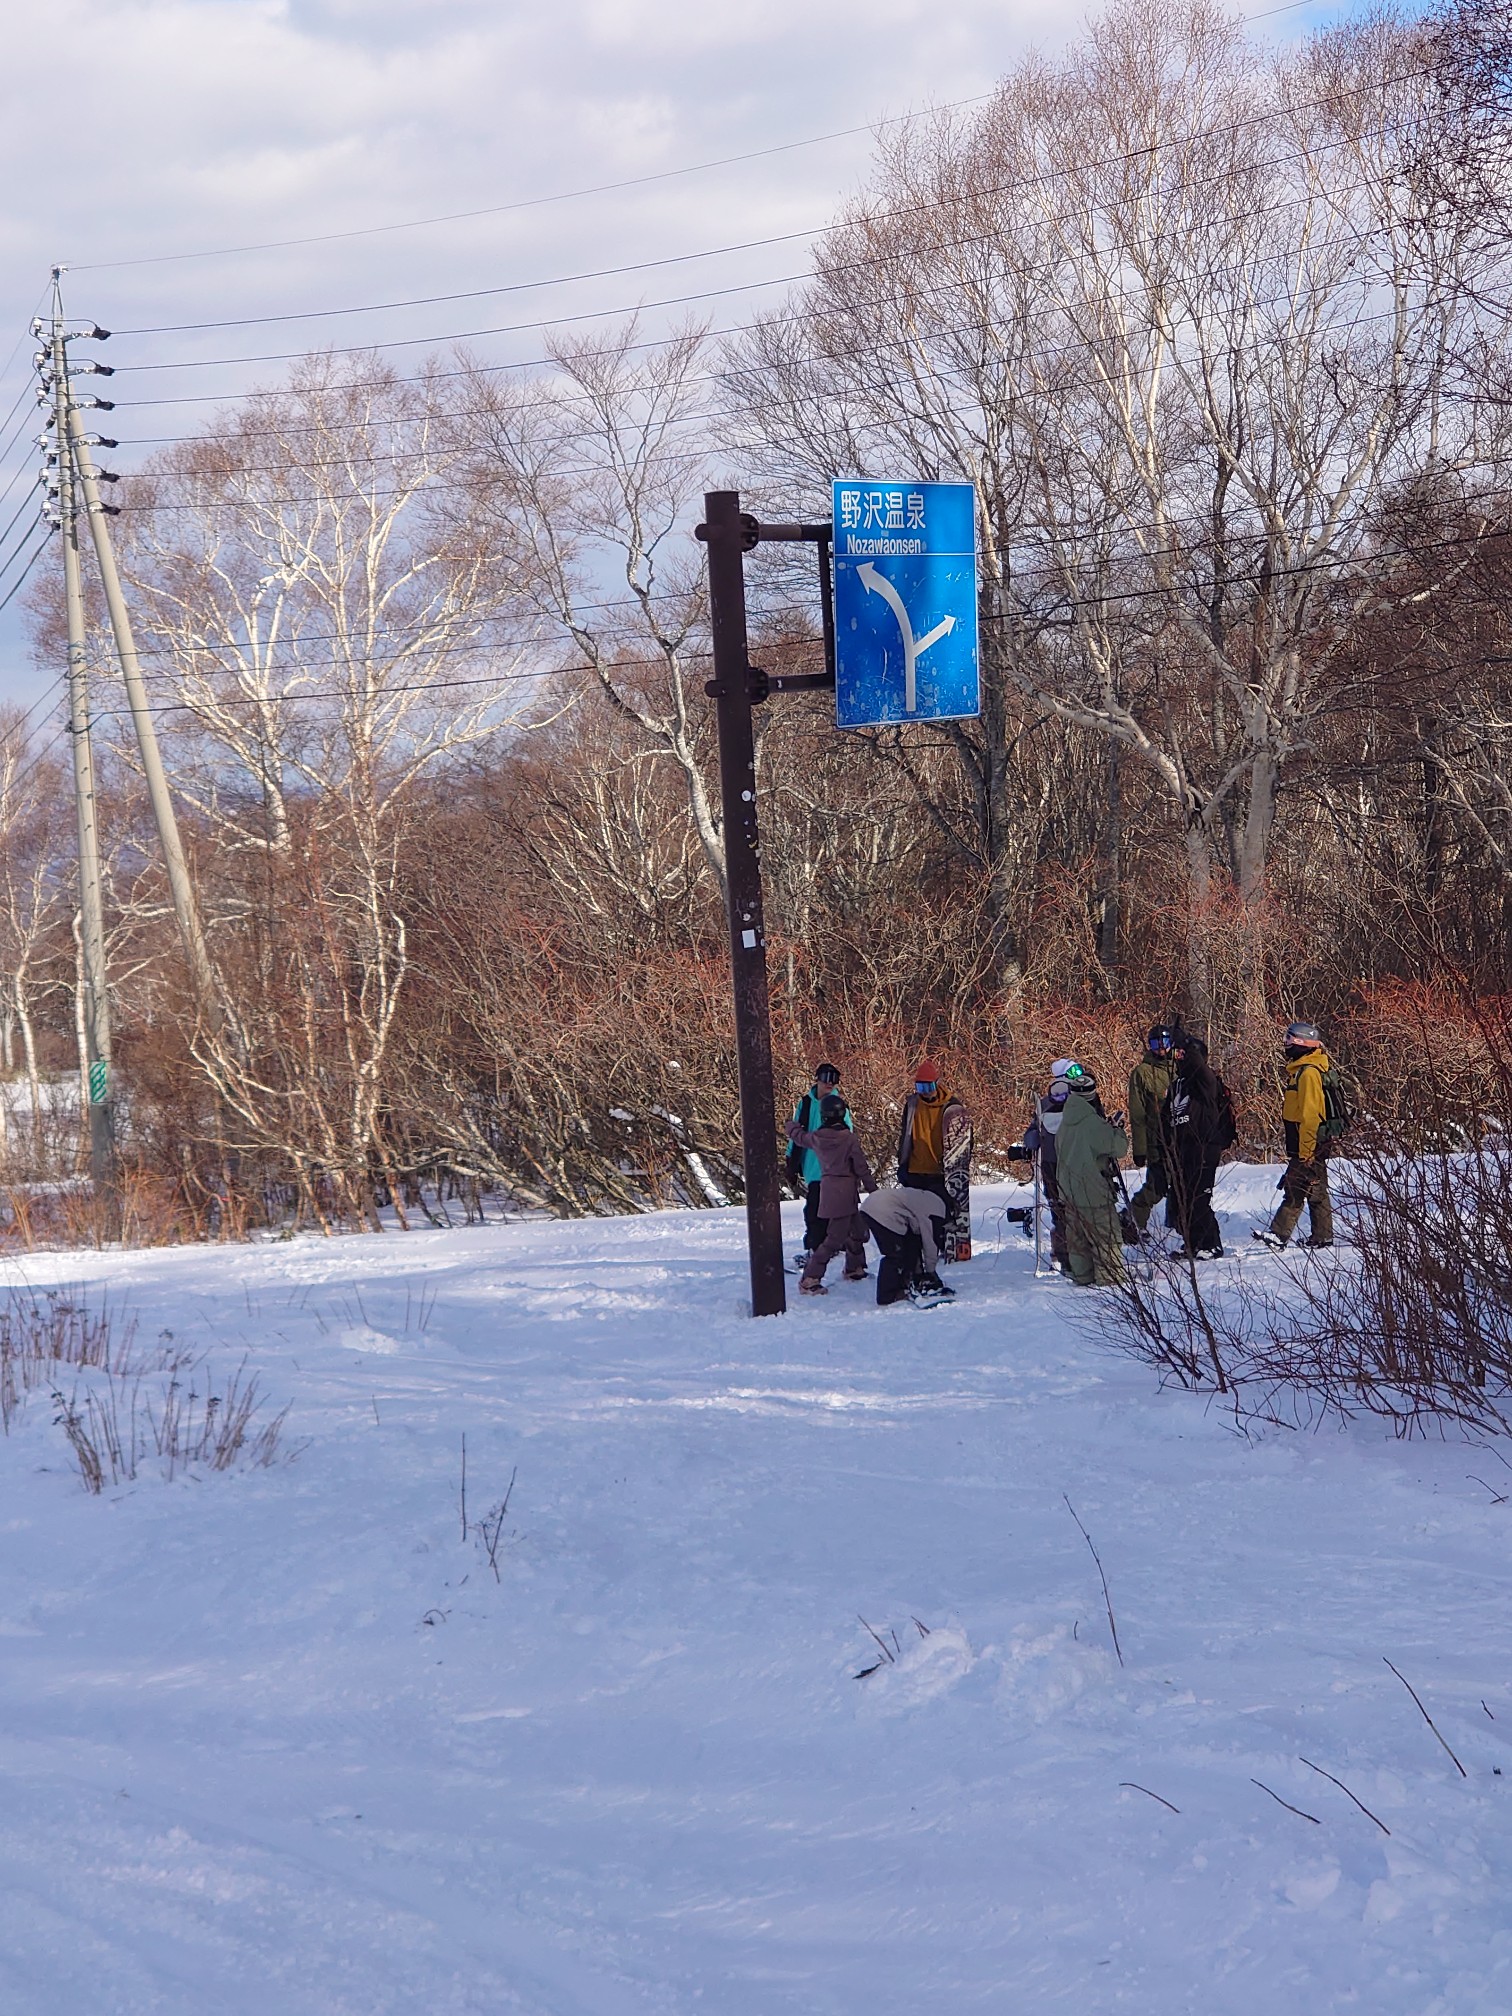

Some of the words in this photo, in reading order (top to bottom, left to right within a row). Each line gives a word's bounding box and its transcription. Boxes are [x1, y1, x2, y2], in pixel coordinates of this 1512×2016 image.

[841, 491, 926, 529] 野沢温泉
[846, 533, 922, 554] Nozawaonsen
